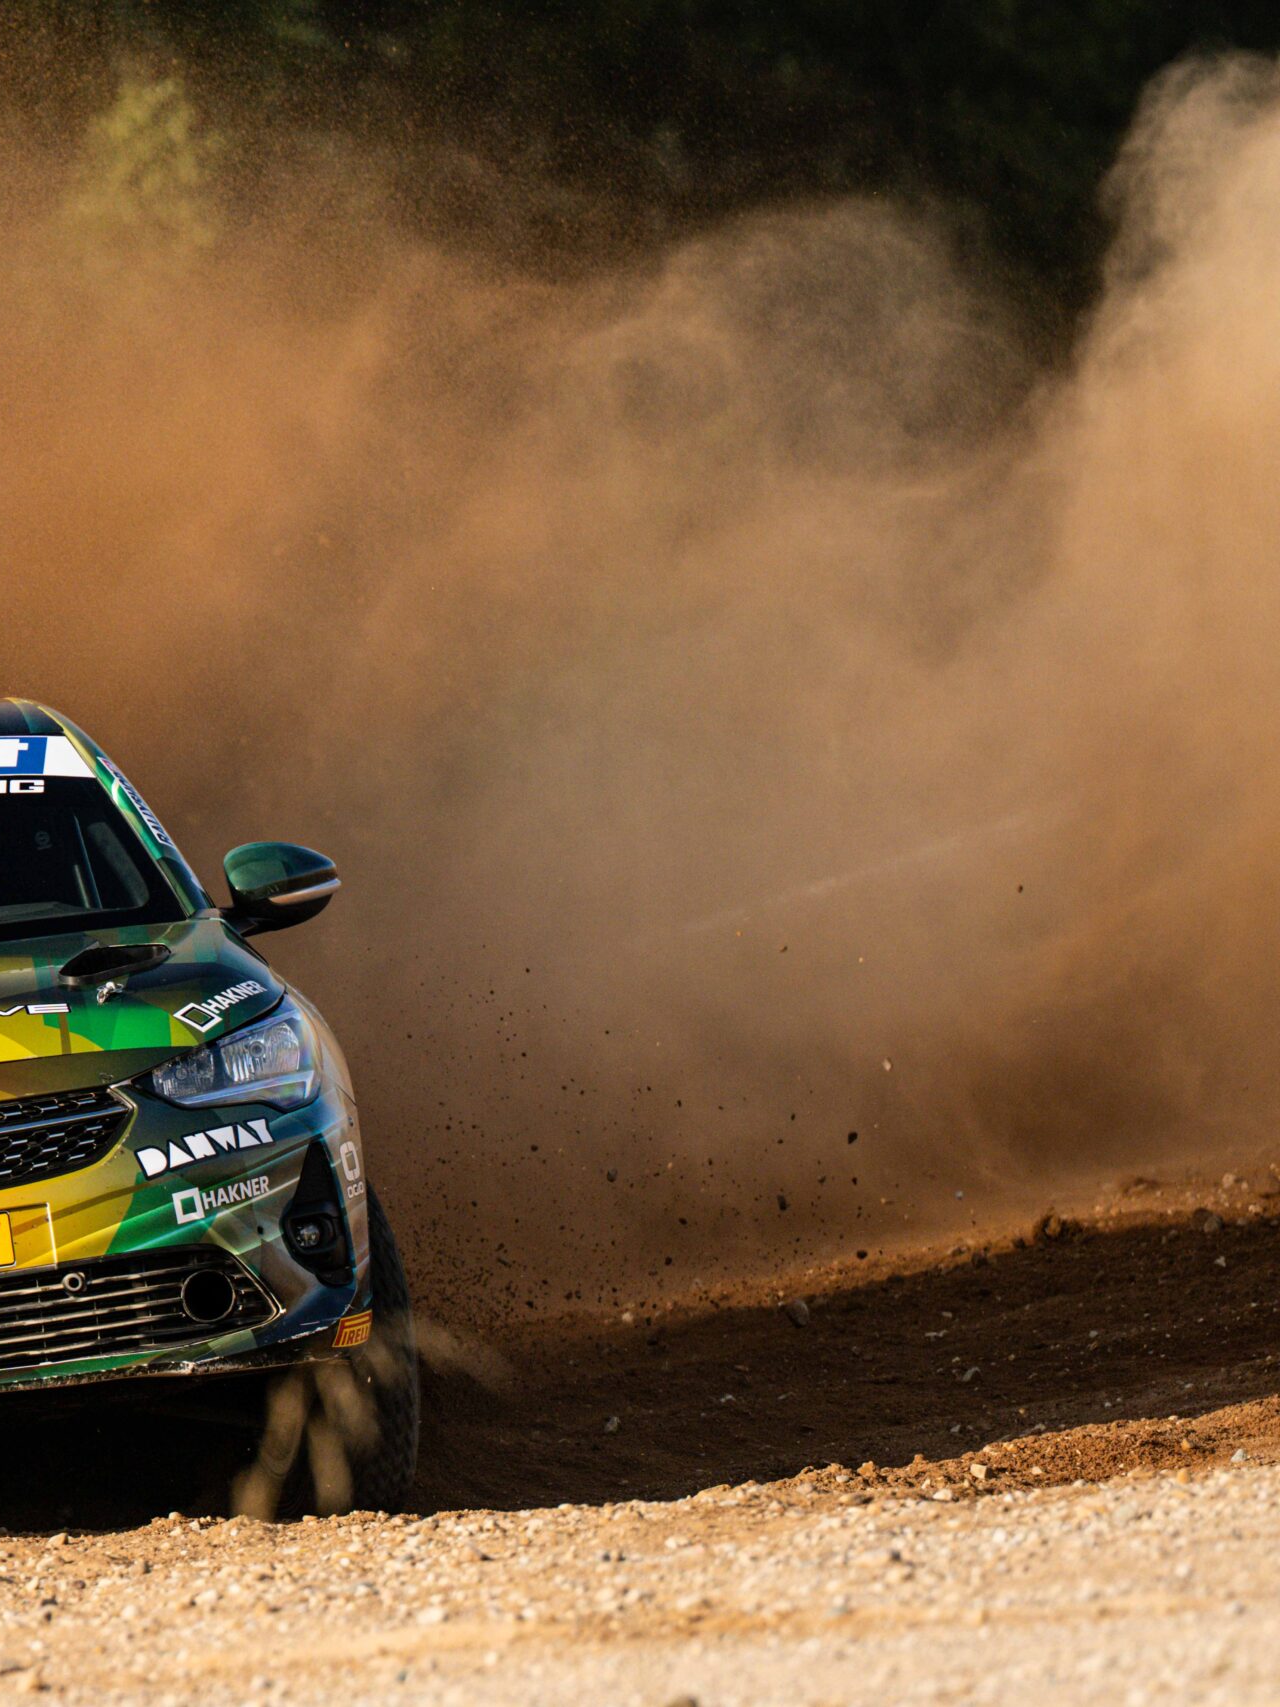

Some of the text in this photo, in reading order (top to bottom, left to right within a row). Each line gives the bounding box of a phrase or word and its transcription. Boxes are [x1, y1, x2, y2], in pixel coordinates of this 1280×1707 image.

[202, 979, 268, 1015] HAKNER
[136, 1117, 274, 1178] DANWAY
[203, 1174, 270, 1210] HAKNER
